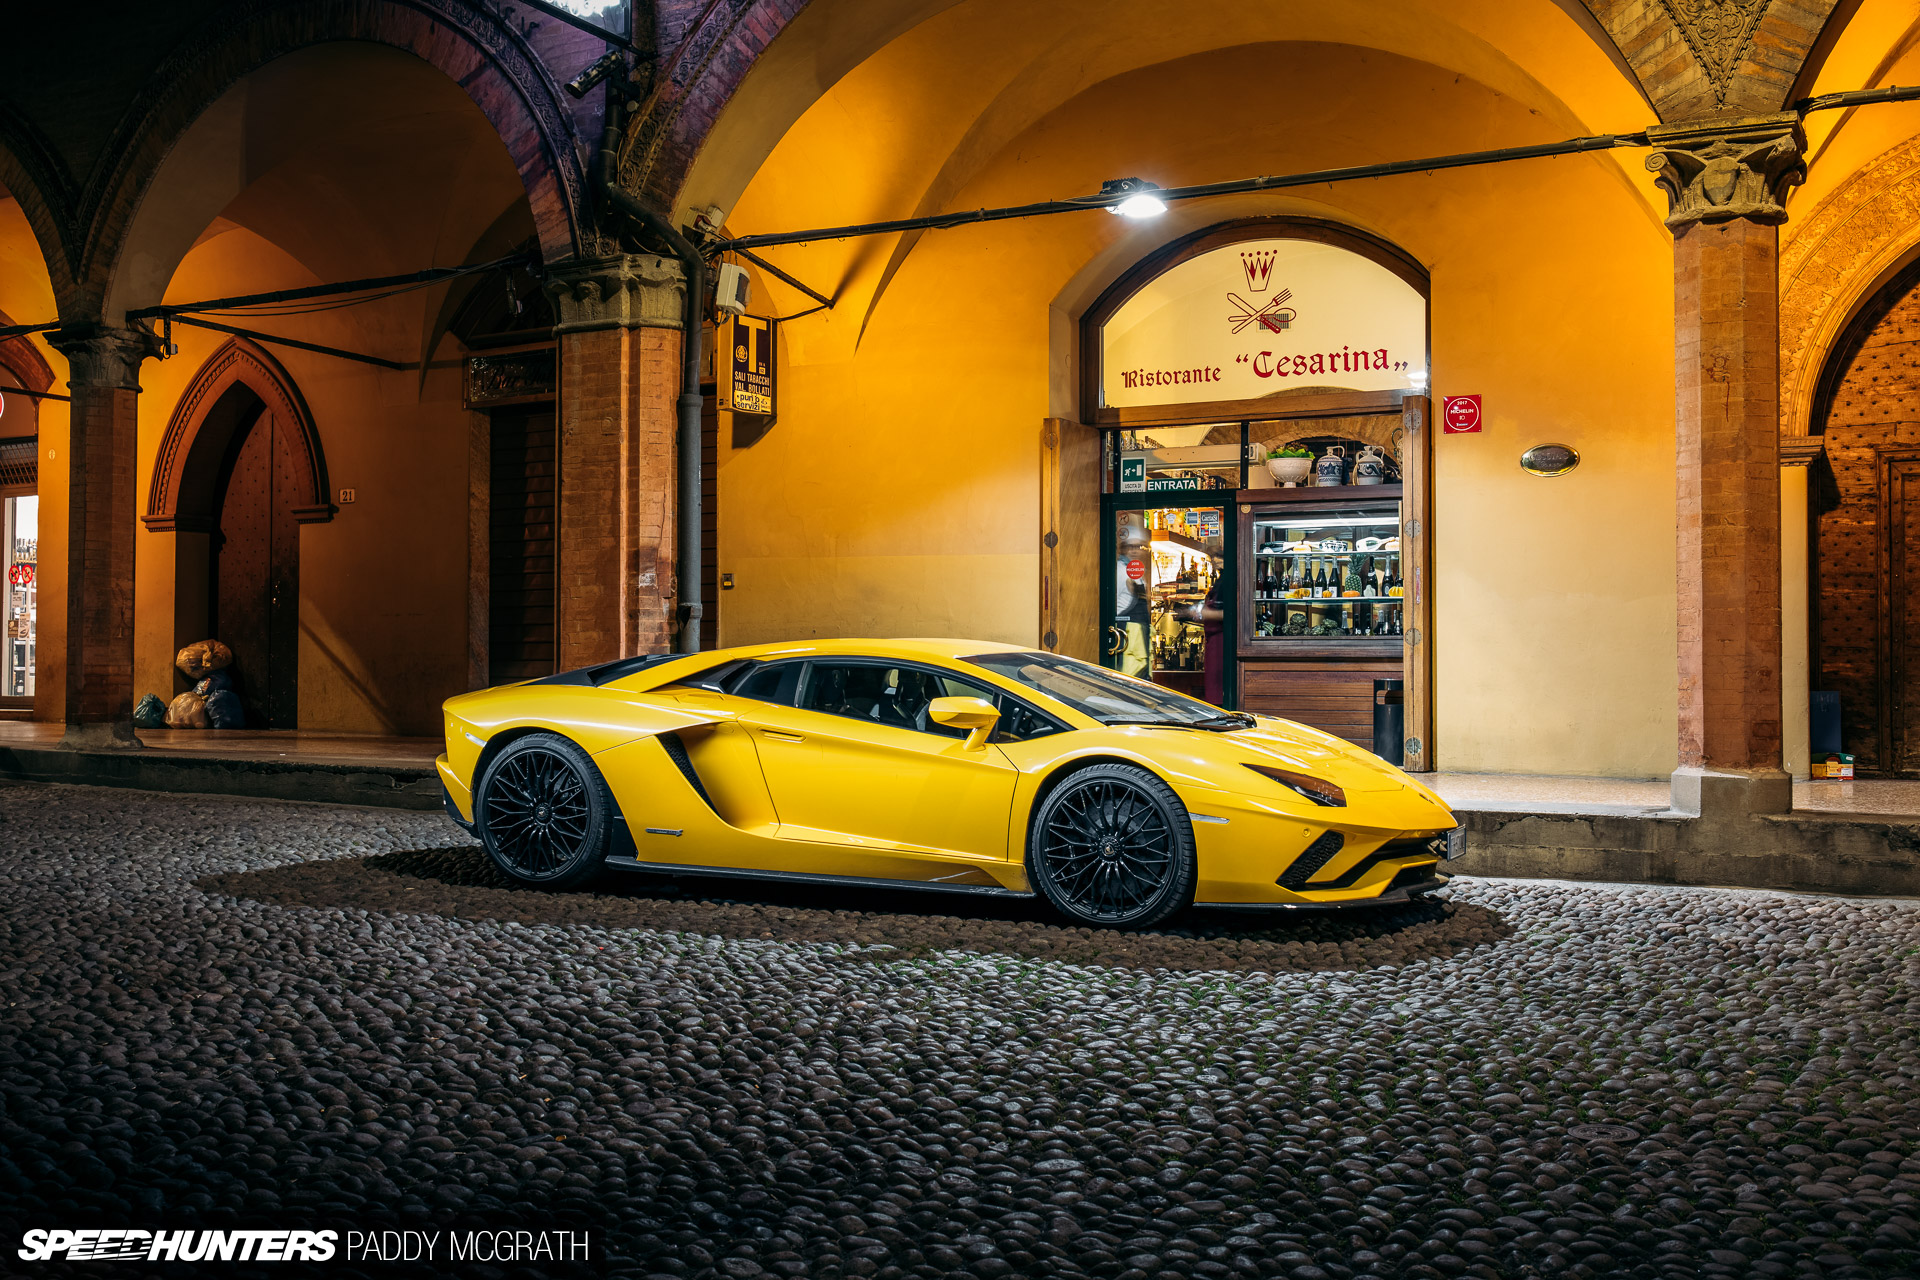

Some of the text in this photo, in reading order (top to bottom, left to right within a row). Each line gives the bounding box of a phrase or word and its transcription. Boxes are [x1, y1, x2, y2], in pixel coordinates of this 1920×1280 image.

[738, 314, 767, 373] T
[734, 370, 746, 381] SALI
[747, 373, 770, 386] TABACCHI
[1120, 366, 1221, 389] Ristorante
[734, 381, 770, 396] VAL. BOLLATI
[736, 400, 760, 410] servizi
[1147, 479, 1197, 490] ENTRATA
[342, 490, 353, 502] 21
